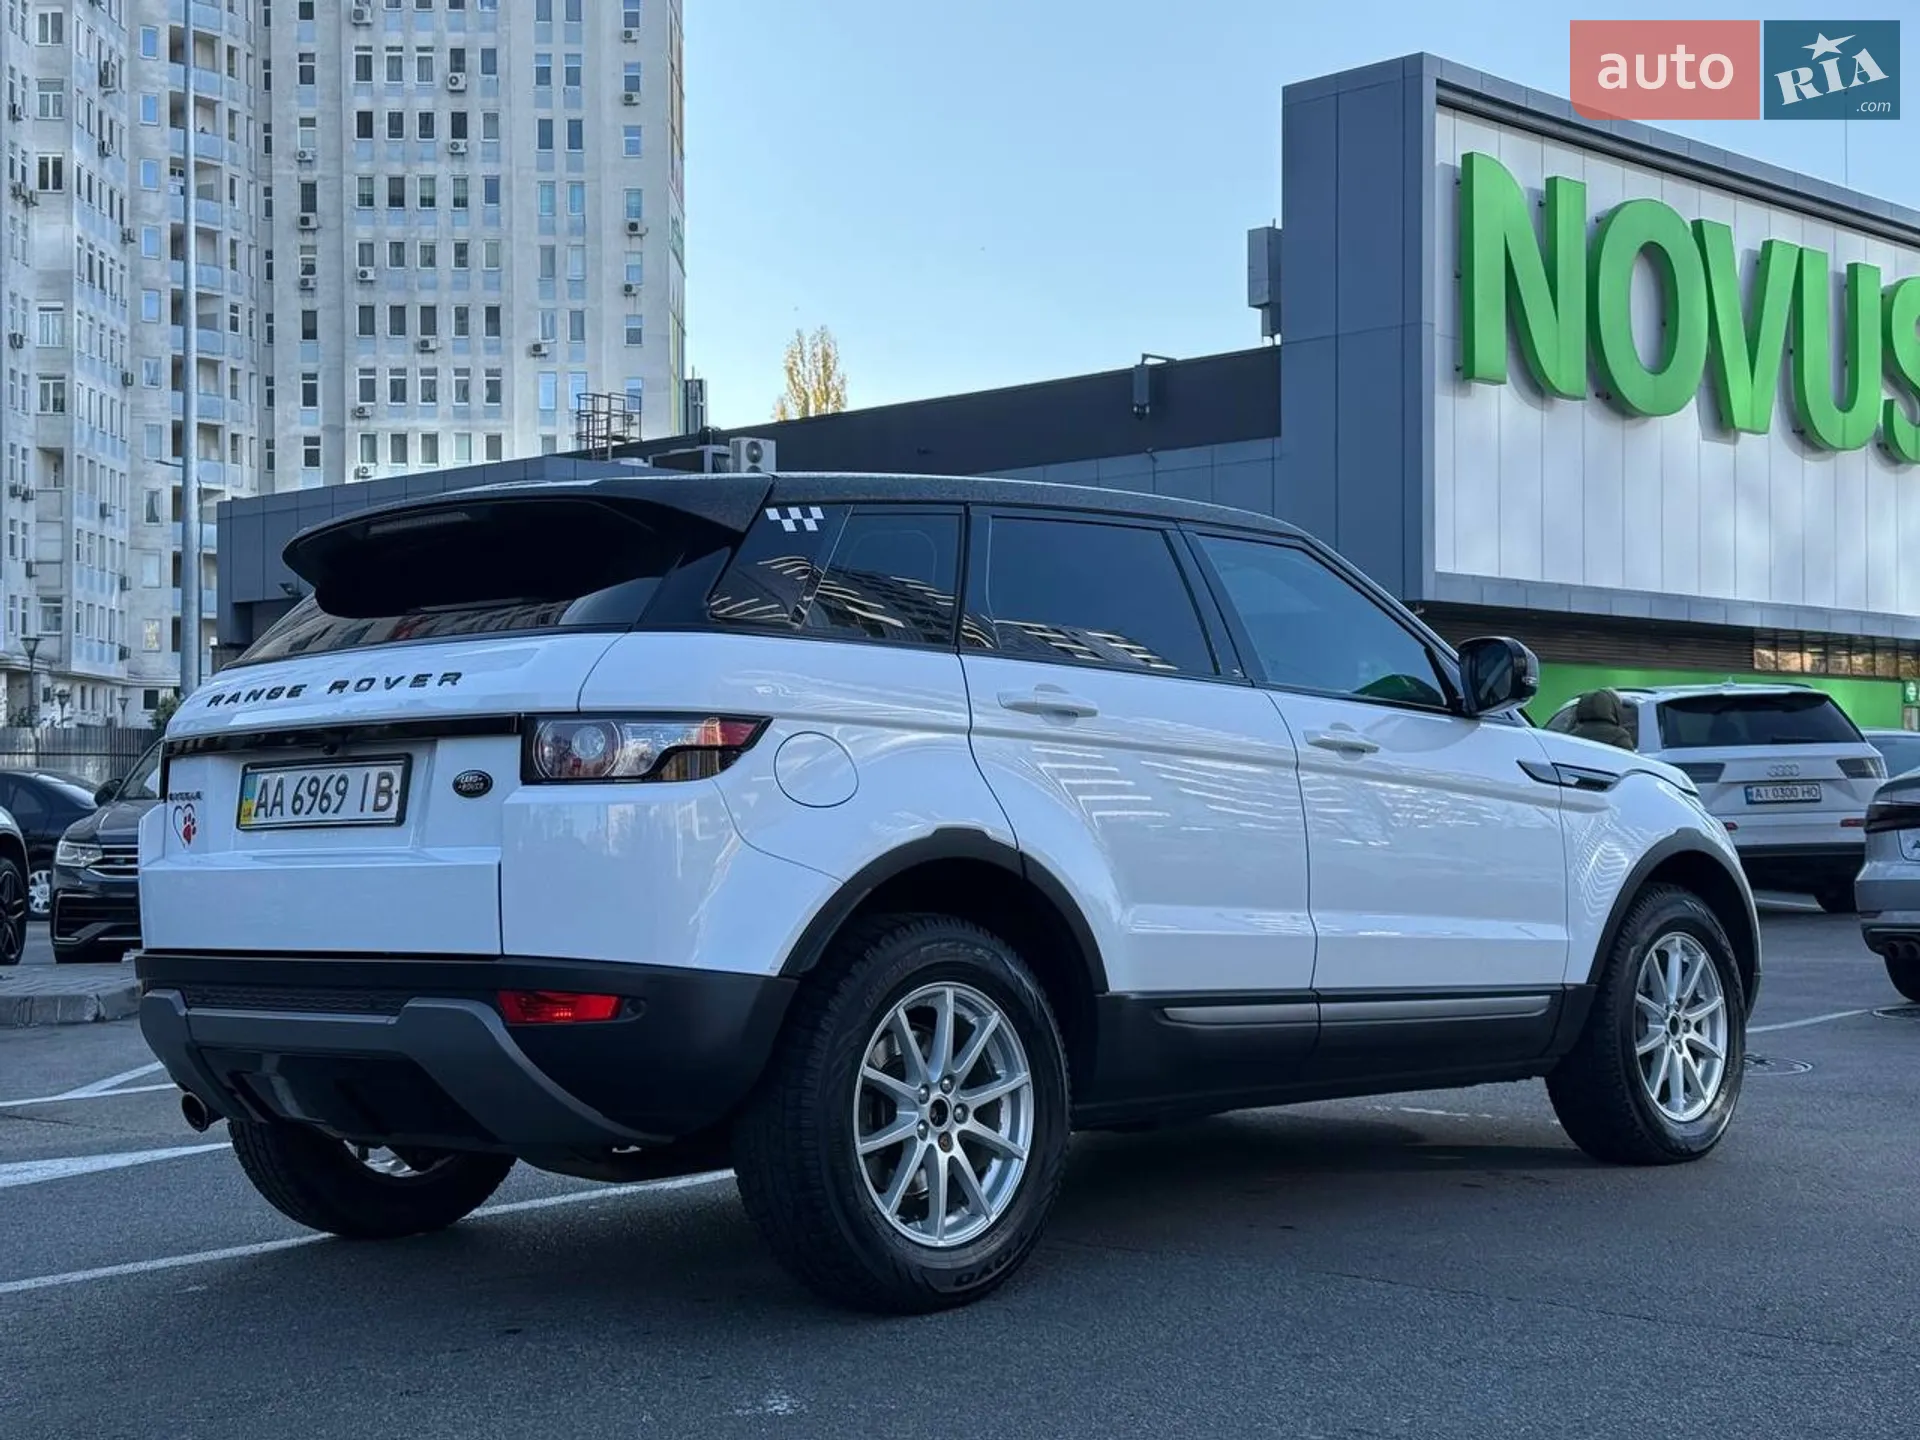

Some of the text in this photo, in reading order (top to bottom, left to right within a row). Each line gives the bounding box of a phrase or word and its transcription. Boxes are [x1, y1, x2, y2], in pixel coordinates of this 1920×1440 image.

[206, 672, 463, 708] RANGE ROVER
[254, 771, 394, 818] AA 6969 IB
